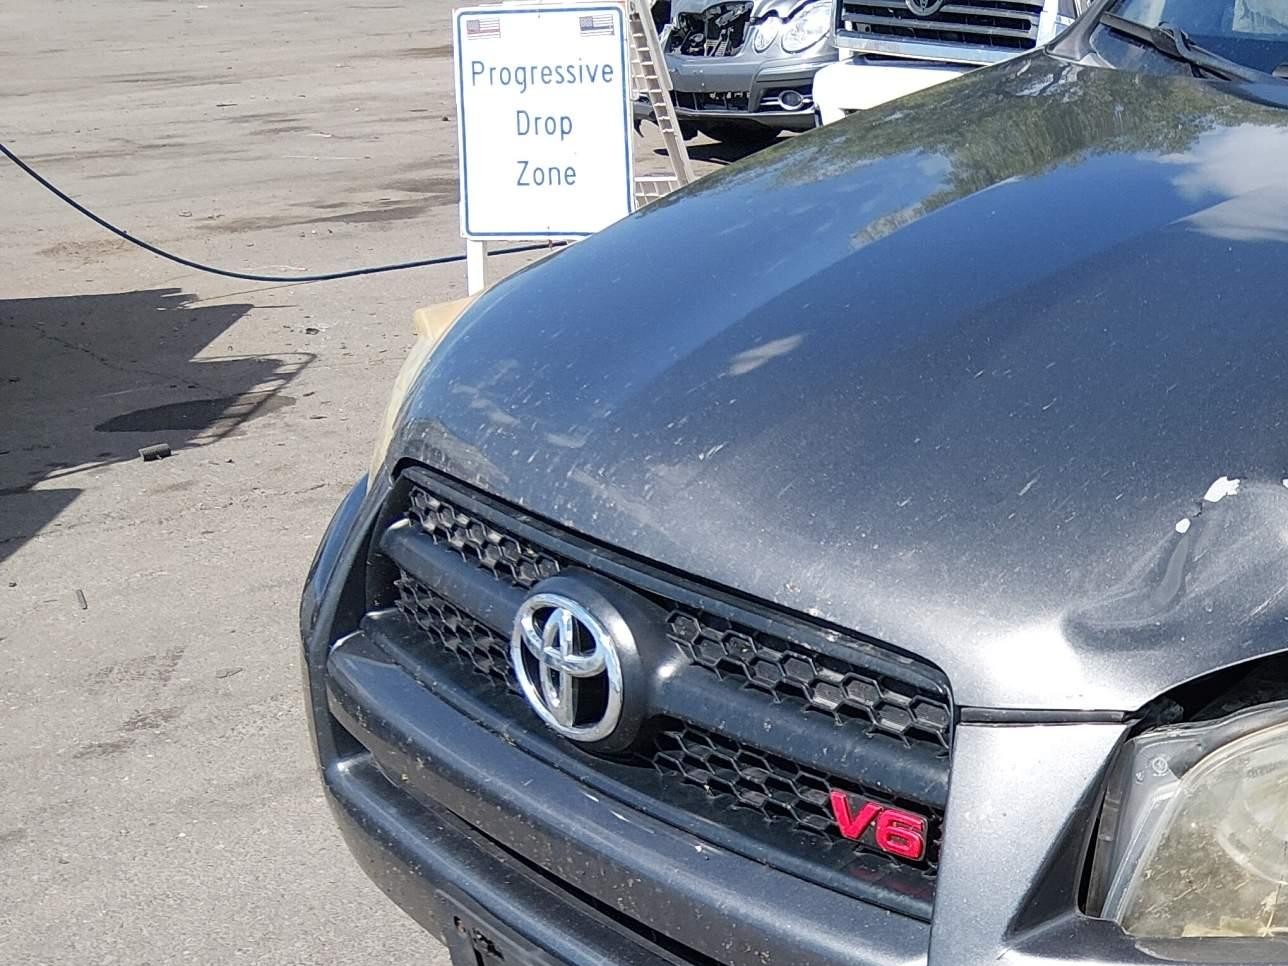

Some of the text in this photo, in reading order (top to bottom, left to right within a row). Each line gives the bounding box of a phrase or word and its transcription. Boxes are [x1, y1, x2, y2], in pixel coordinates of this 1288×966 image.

[471, 58, 615, 94] Progressive
[516, 110, 573, 141] Drop
[516, 160, 577, 187] Zone
[830, 789, 925, 861] V6
